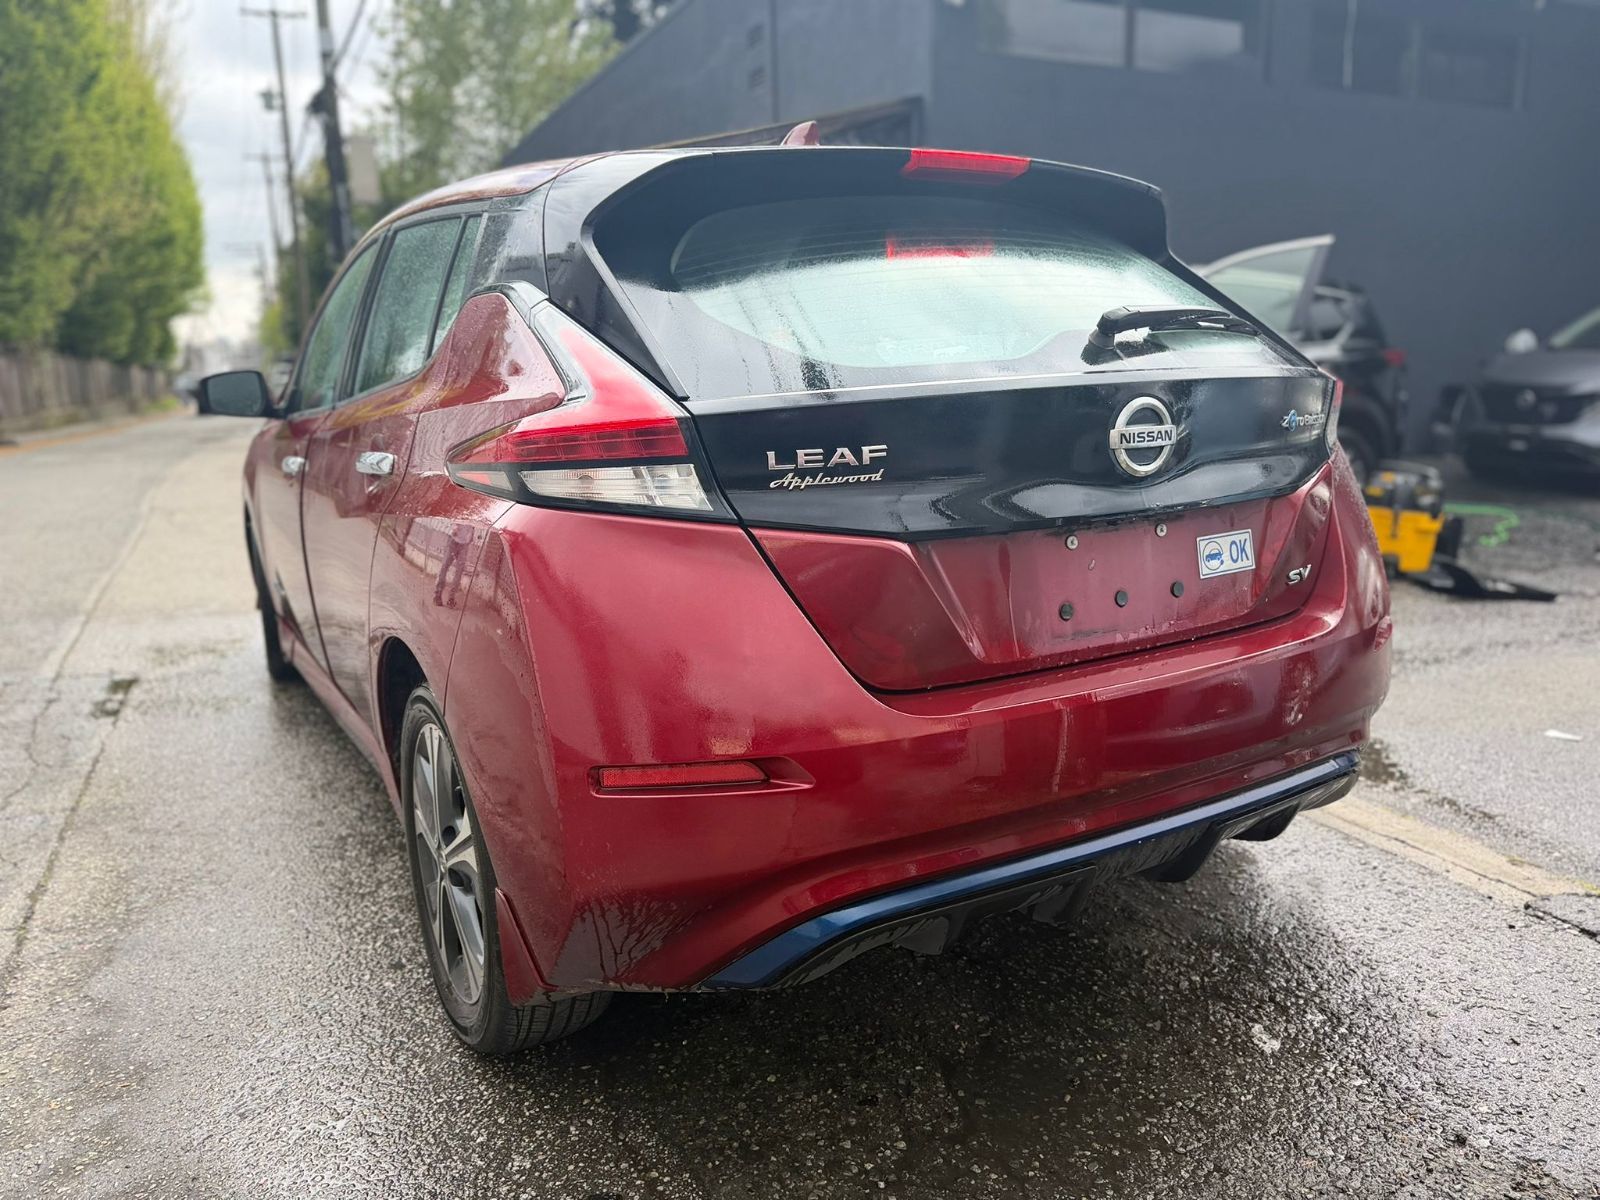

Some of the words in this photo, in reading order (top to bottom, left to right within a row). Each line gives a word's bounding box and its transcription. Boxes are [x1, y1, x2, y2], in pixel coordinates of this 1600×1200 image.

[1119, 429, 1173, 445] NISSAN
[766, 444, 888, 470] LEAF
[769, 468, 885, 490] Applewood
[1229, 538, 1250, 563] OK
[1287, 564, 1312, 585] SV
